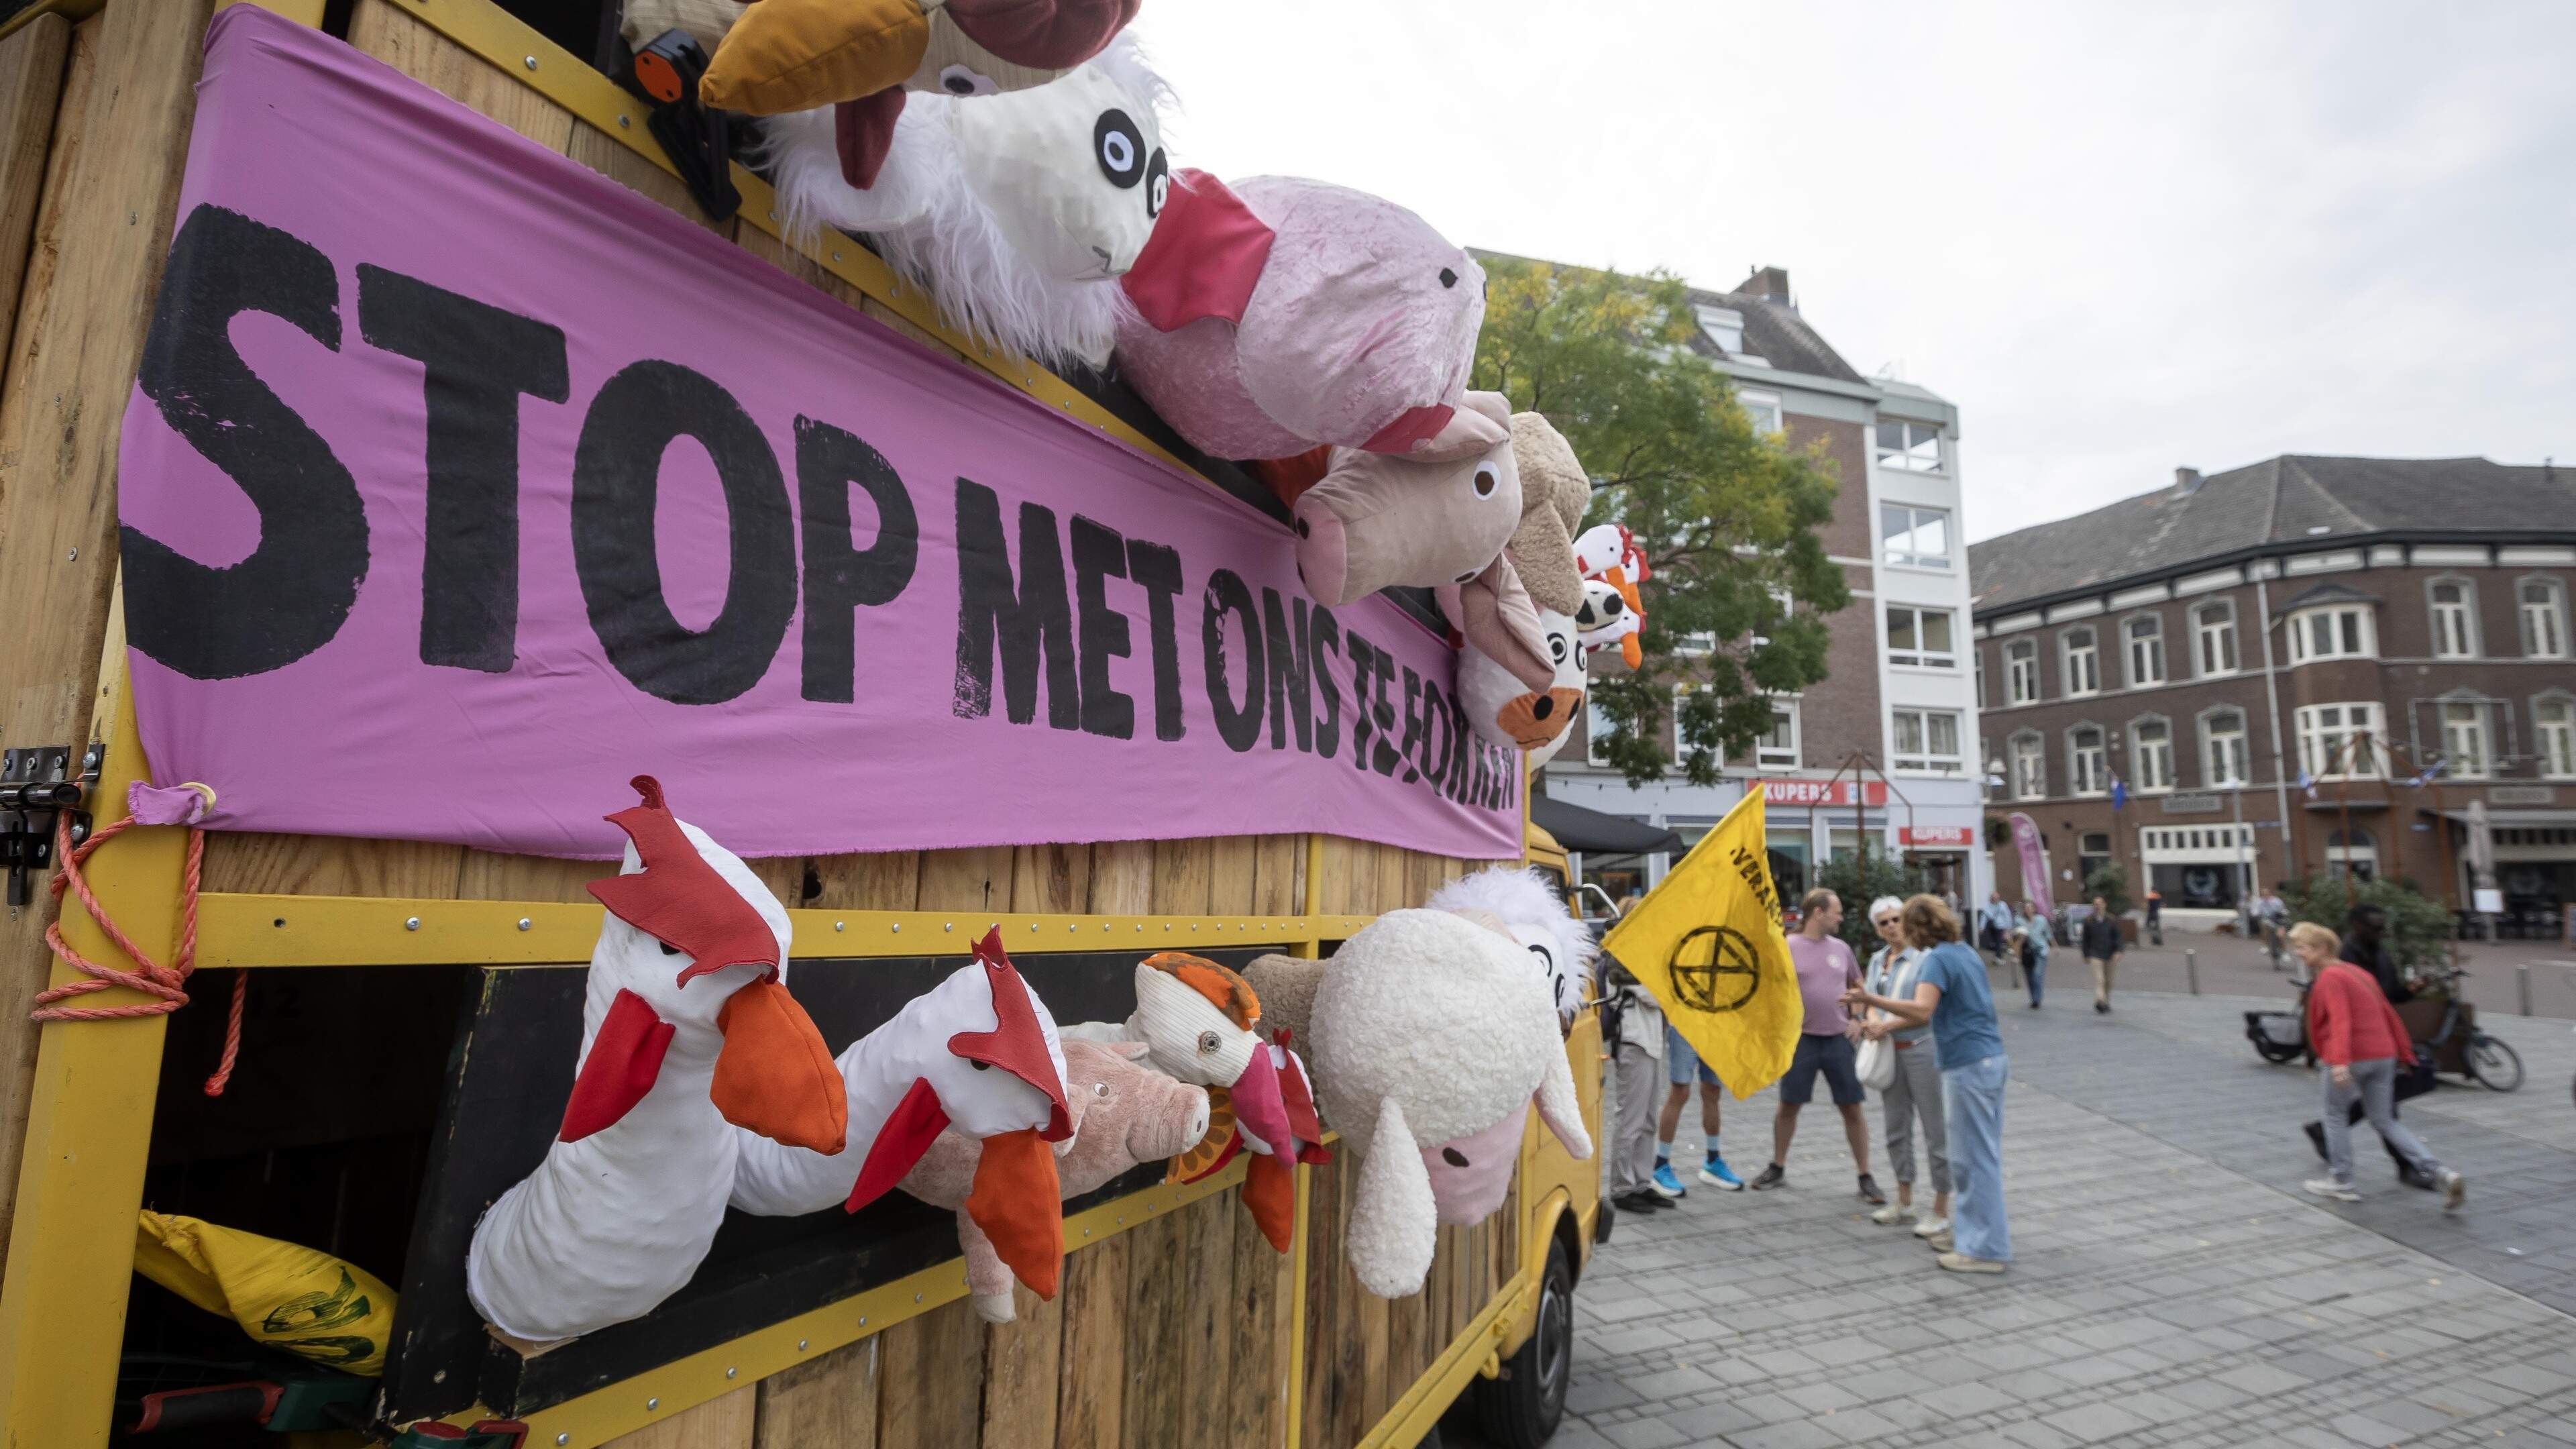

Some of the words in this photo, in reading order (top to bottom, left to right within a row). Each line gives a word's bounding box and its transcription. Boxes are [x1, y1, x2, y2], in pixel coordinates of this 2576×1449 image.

[119, 203, 918, 704] STOP
[953, 476, 1185, 742] MET
[1202, 568, 1340, 759] ONS
[1347, 629, 1401, 777] TE
